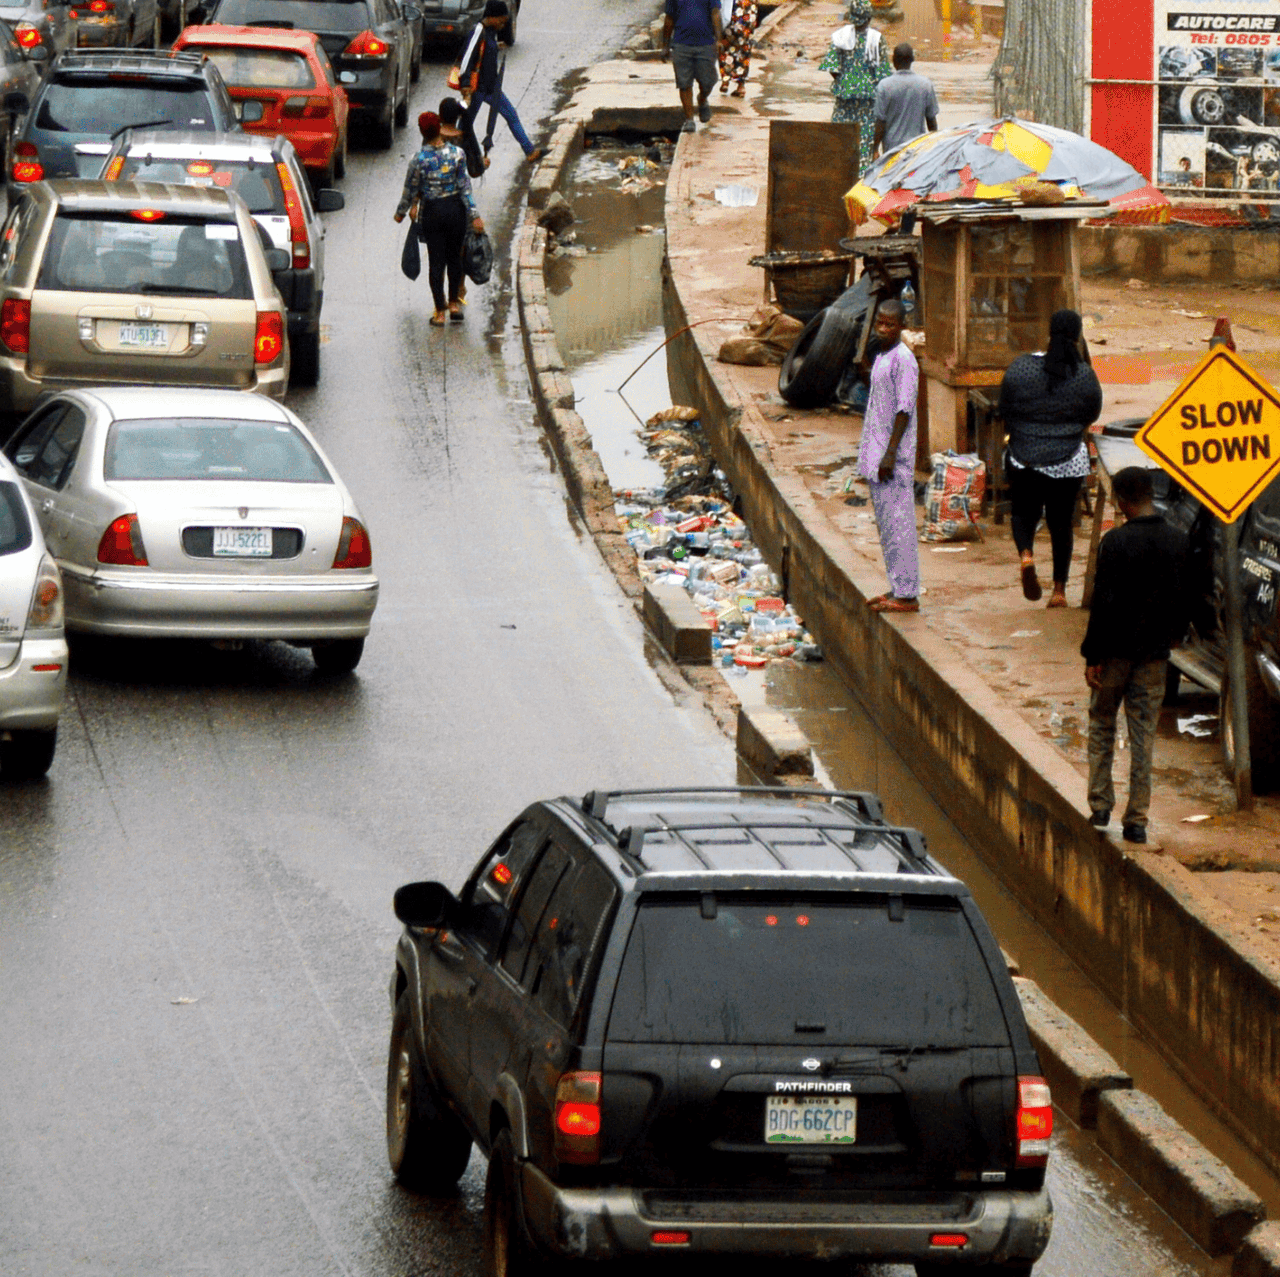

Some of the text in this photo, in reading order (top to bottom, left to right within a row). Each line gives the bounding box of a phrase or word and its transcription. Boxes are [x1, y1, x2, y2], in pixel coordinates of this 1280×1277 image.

[1174, 15, 1277, 30] AUTOCARE
[1191, 33, 1218, 45] Tel:
[1225, 34, 1271, 46] 0805
[1180, 398, 1263, 430] SLOW
[1182, 434, 1271, 466] DOWN
[775, 1082, 852, 1092] PATHFINDER
[770, 1109, 854, 1131] BDG-662CP
